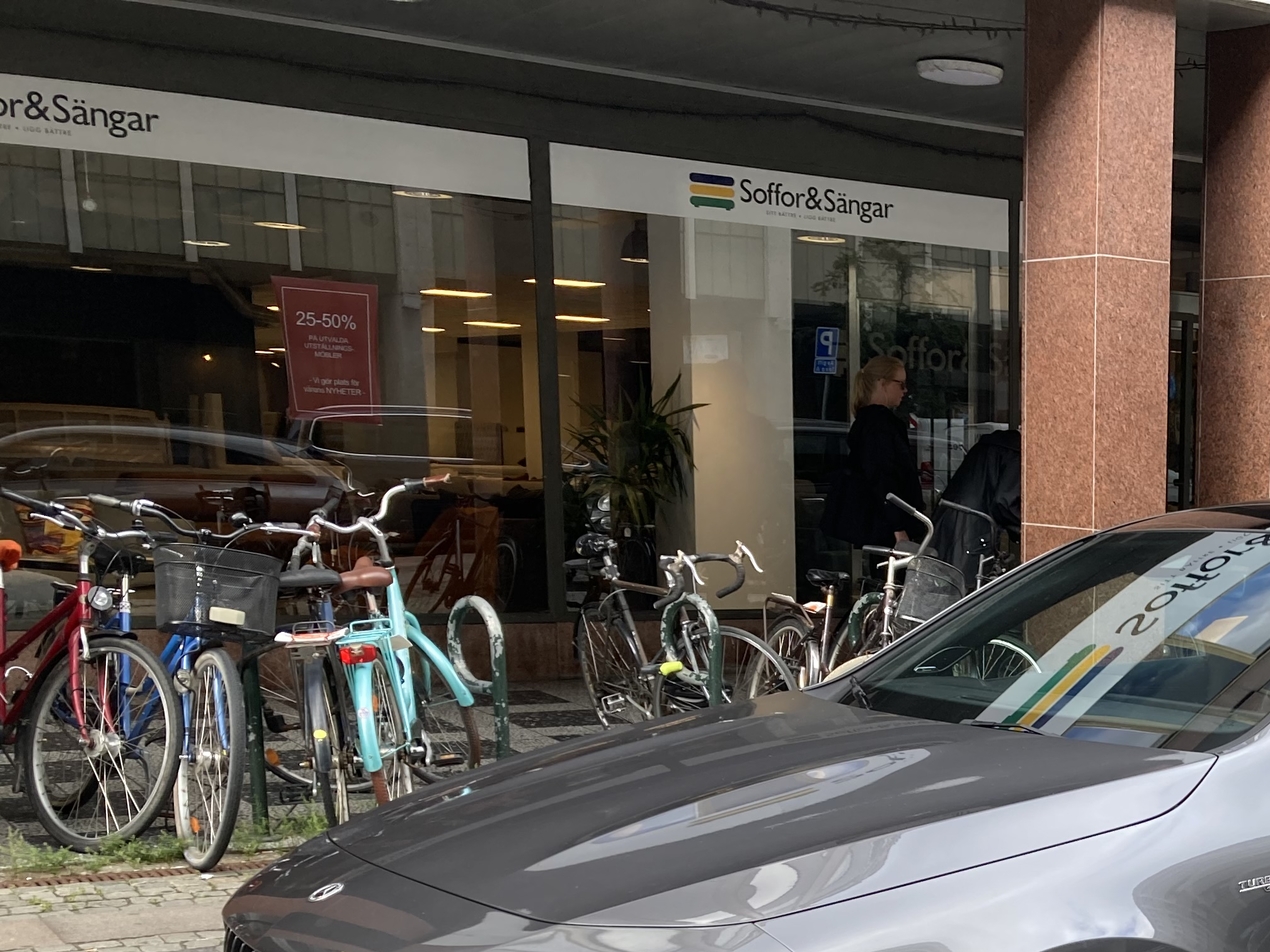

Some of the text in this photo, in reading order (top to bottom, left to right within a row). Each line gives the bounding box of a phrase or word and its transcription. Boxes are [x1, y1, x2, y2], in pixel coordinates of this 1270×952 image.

[739, 178, 894, 224] Soffor&Sängar
[295, 310, 357, 330] 25-50%
[325, 387, 362, 396] NYHETER
